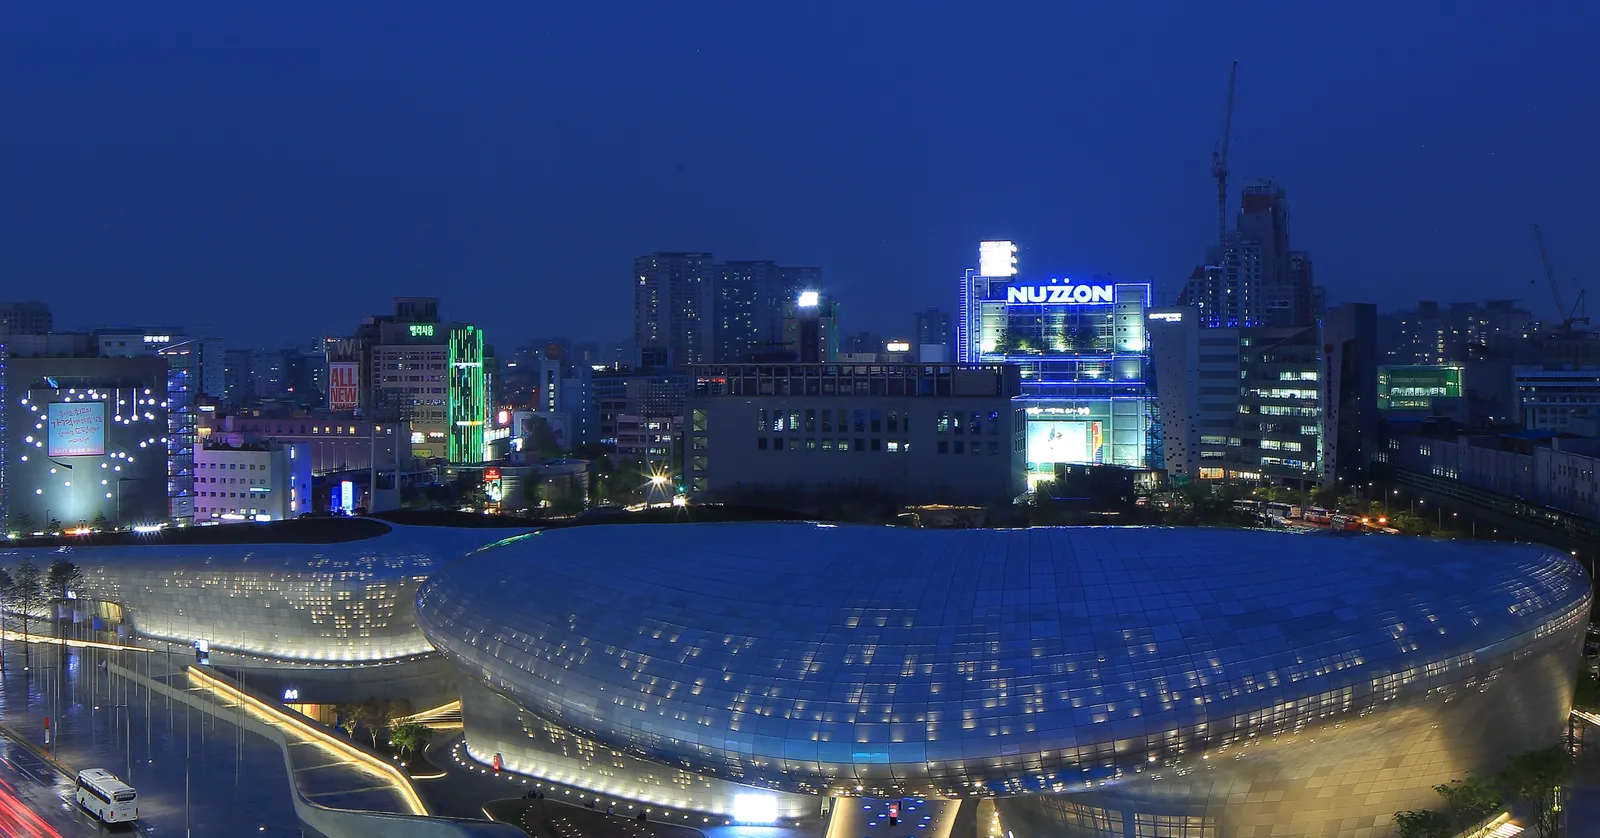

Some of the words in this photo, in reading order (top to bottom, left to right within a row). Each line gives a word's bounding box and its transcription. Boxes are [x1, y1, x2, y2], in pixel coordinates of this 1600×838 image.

[1007, 278, 1113, 303] NUZZON
[331, 368, 357, 387] ALL
[331, 388, 357, 402] NEW
[284, 689, 298, 699] A1
